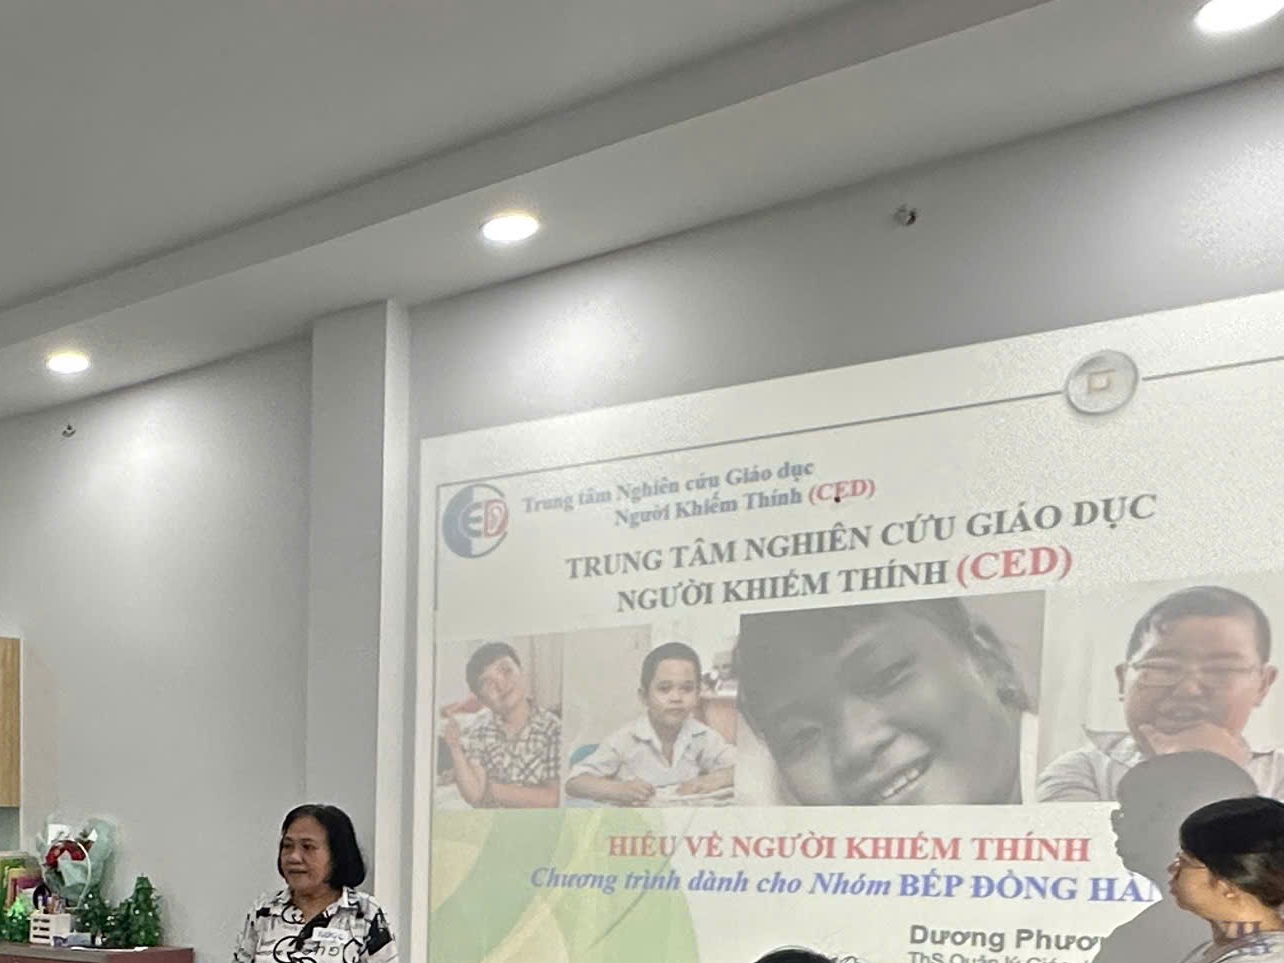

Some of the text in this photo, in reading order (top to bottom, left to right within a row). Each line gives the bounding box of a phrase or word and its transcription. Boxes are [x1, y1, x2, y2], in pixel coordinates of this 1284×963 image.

[522, 461, 814, 513] Trung tâm Nghiên cứu Giáo dục
[614, 479, 876, 529] Người Khiếm Thính (CED)
[565, 493, 1158, 581] TRUNG TÂM NGHIÊN CỨU GIÁO DỤC
[617, 545, 1074, 613] NGƯỜI KHIẾM THÍNH (CED)
[732, 831, 836, 860] NGƯỜI
[845, 830, 963, 861] KHIẾM
[970, 830, 1093, 863] THÍNH
[530, 866, 617, 894] Chương
[624, 868, 681, 892] trình
[688, 869, 749, 893] dành
[757, 871, 802, 894] cho
[808, 871, 892, 896] Nhóm
[898, 868, 965, 898] BẾP
[970, 869, 1078, 901] ĐỒNG
[909, 925, 1006, 953] Dương
